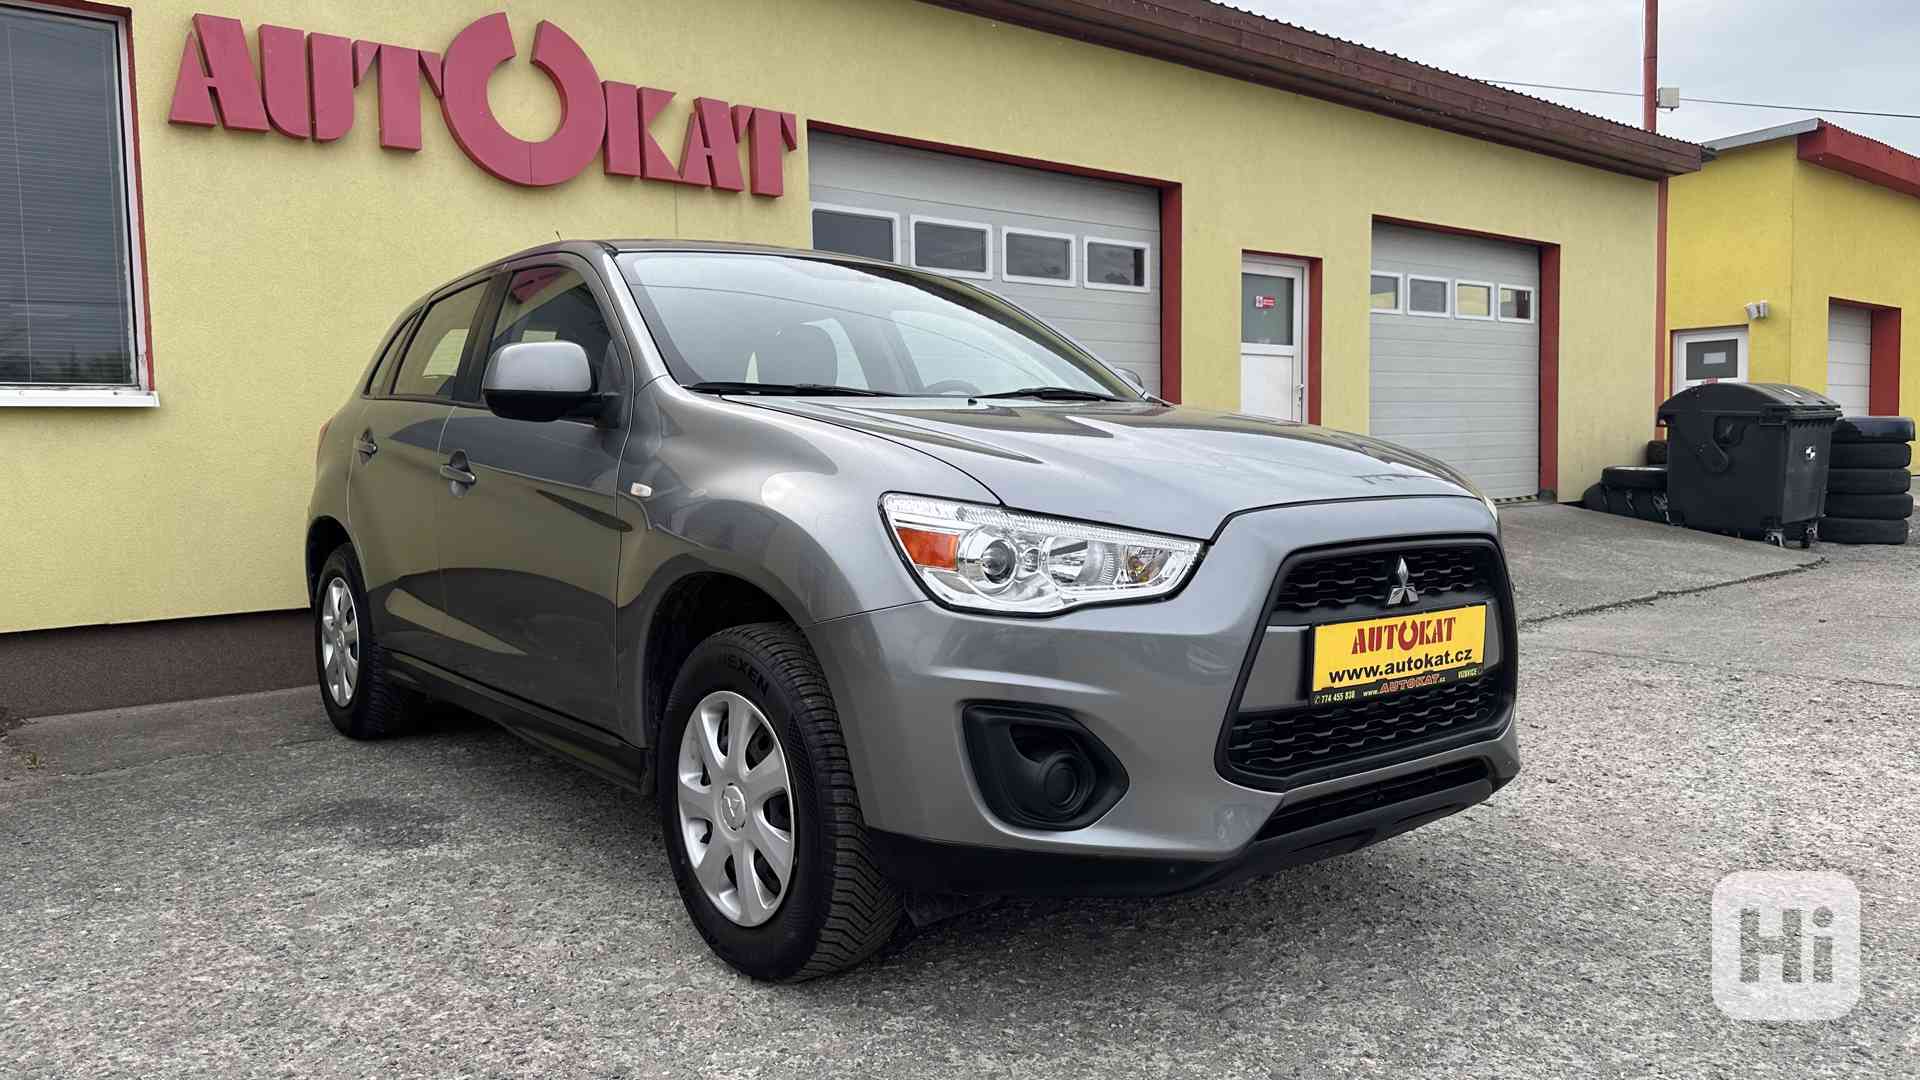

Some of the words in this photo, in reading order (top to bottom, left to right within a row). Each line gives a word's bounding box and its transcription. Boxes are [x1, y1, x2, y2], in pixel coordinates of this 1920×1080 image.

[167, 11, 798, 198] AUTOKAT
[1351, 616, 1457, 655] AUTOKAT
[1328, 648, 1473, 684] www.autokat.cz
